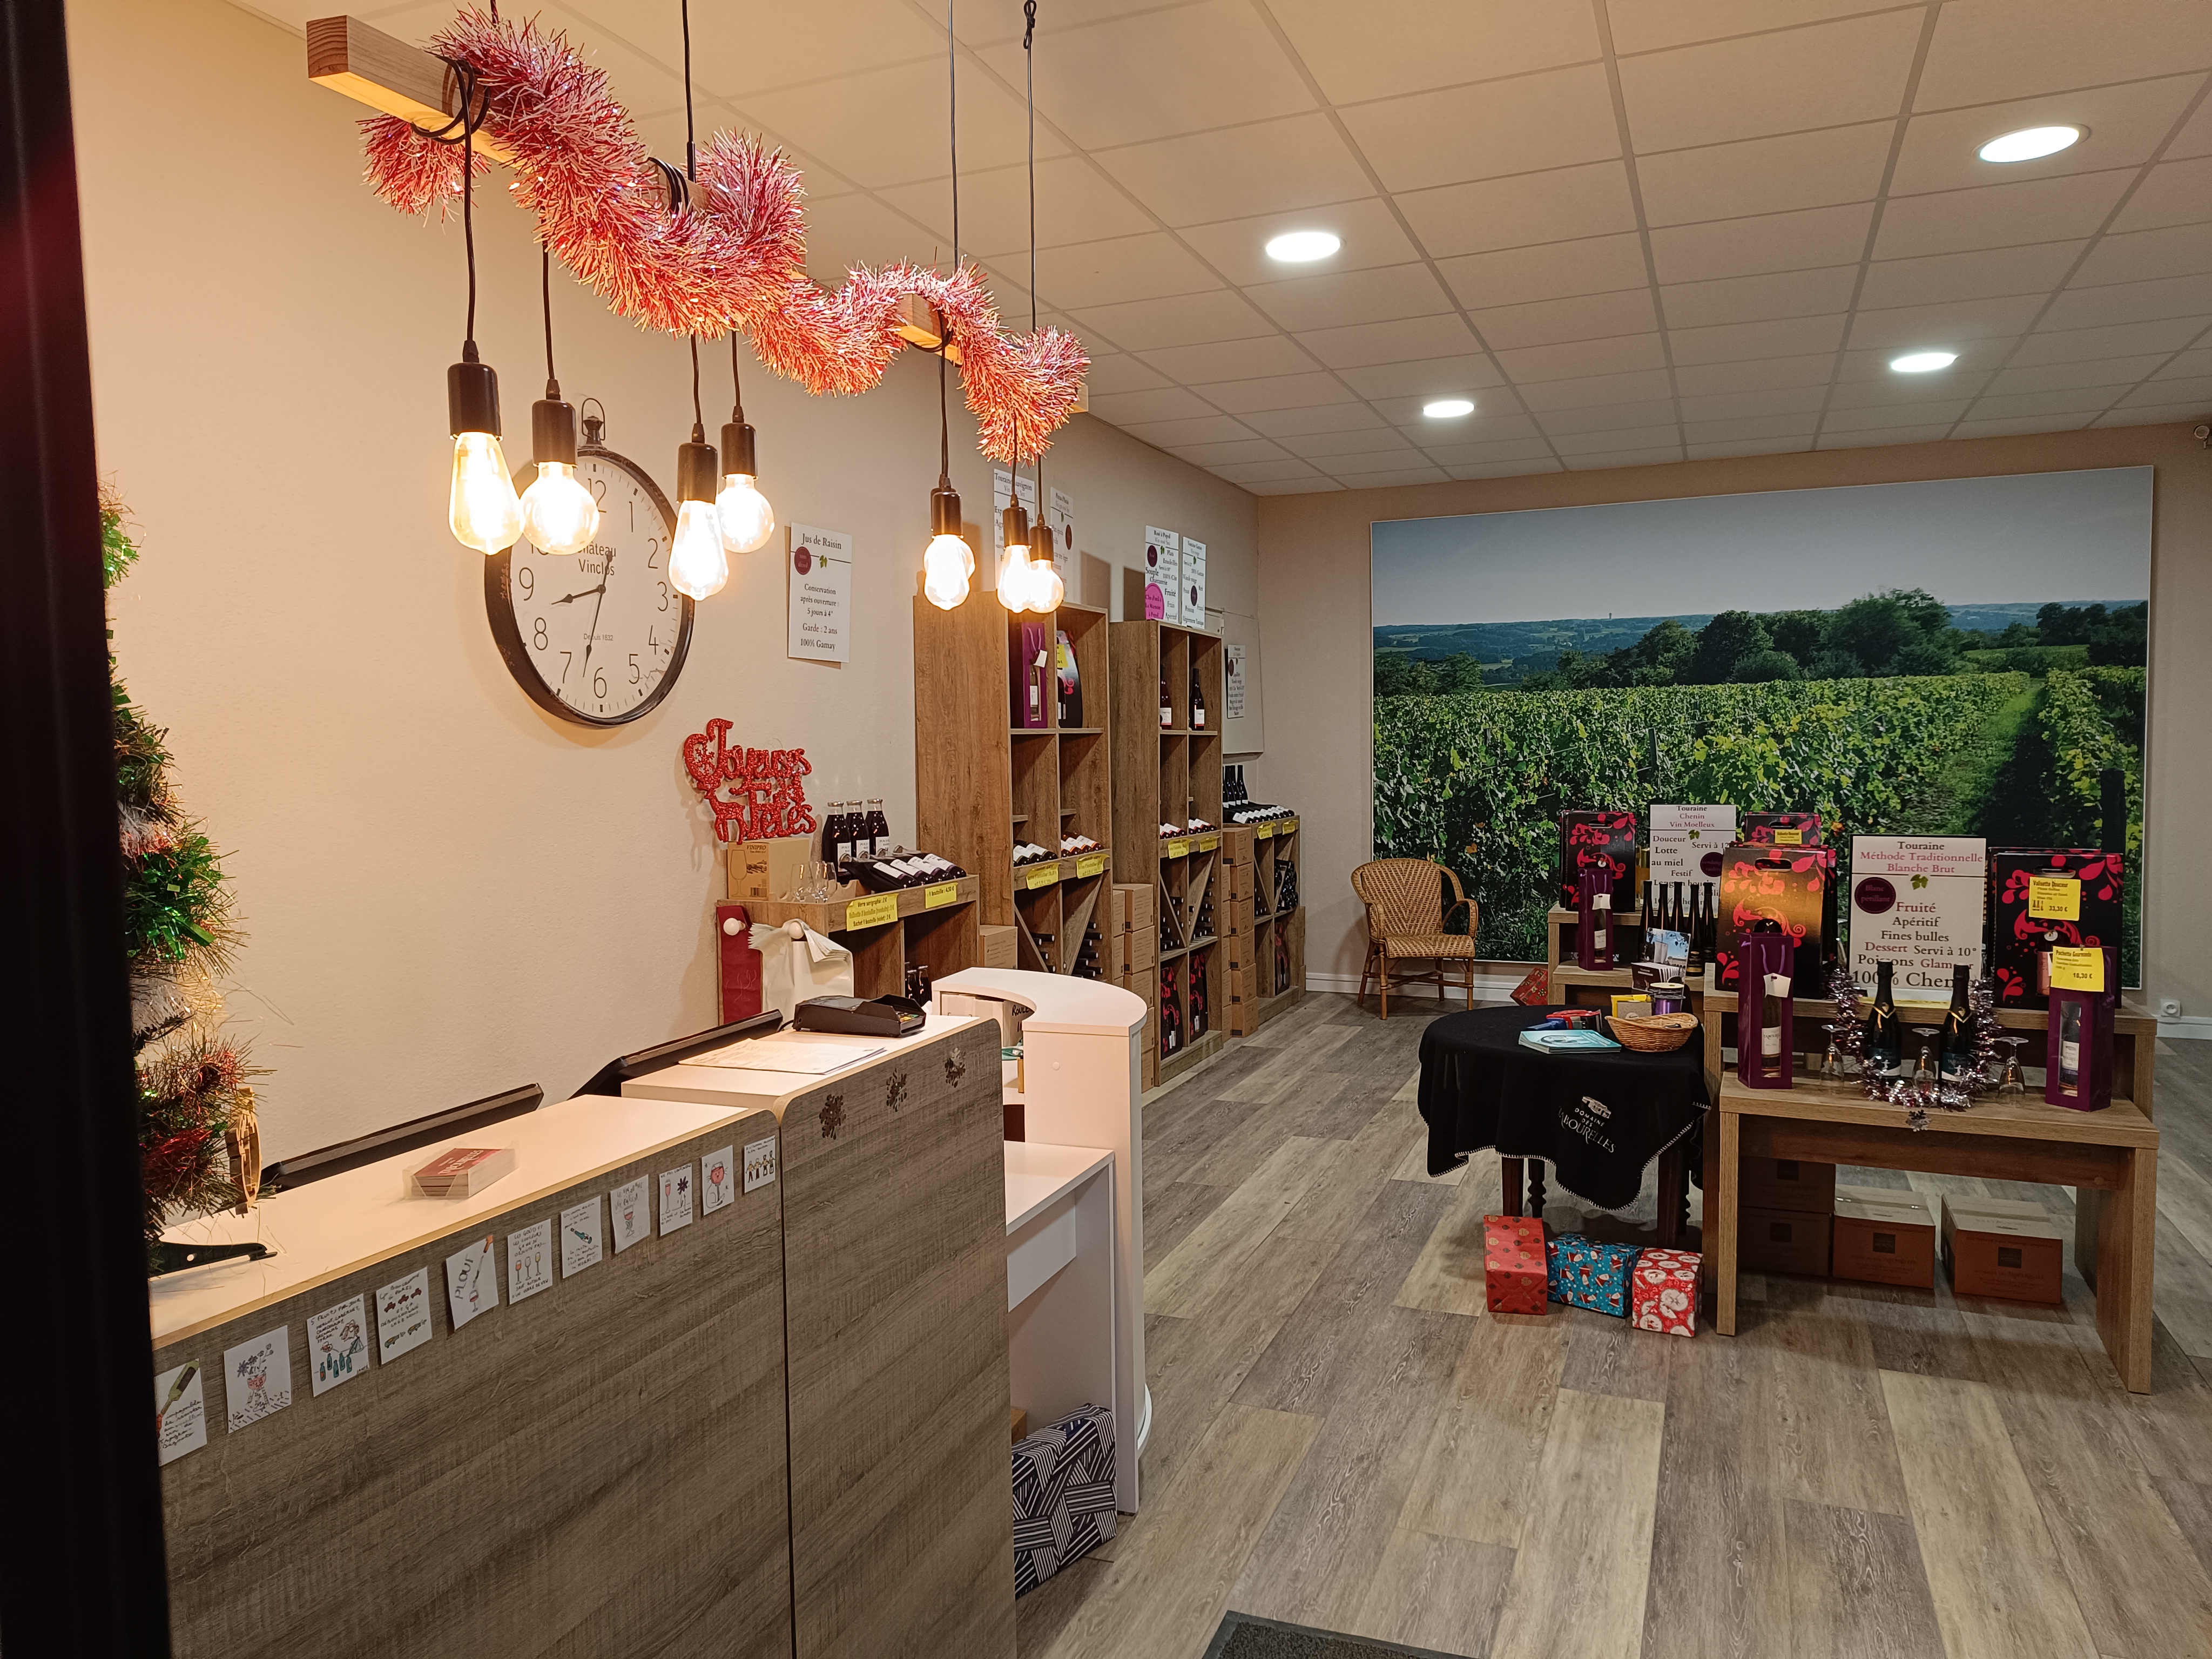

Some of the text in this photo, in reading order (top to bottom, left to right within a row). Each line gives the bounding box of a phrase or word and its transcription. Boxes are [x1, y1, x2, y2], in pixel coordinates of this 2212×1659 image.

[801, 533, 841, 549] Jus de Raisin
[578, 541, 616, 557] hâteau
[648, 538, 658, 569] 2
[578, 558, 615, 576] Vinclos
[519, 567, 534, 601] 9
[804, 583, 836, 595] Conservation
[657, 581, 669, 612] 3
[800, 596, 813, 604] après
[811, 609, 823, 617] jours
[534, 617, 548, 651] 8
[802, 623, 819, 633] Garde
[824, 625, 827, 633] 2
[648, 624, 659, 655] 4
[800, 638, 835, 652] 100% Gamay
[559, 651, 572, 684] 7
[628, 653, 640, 685] 5
[594, 667, 607, 698] 6
[1897, 841, 1945, 849] Touraine
[1860, 852, 1983, 862] Méthode Traditionnelle
[1887, 864, 1955, 873] Blanche Brut
[1896, 901, 1936, 913] Fruité
[1892, 916, 1940, 928] Apéritif
[1880, 930, 1949, 942] Fines bulles
[1865, 942, 1977, 956] Dessert Servi à 10°
[1575, 1108, 1605, 1127] DOMAINE
[1581, 1118, 1593, 1127] DES
[311, 1317, 315, 1325] 5
